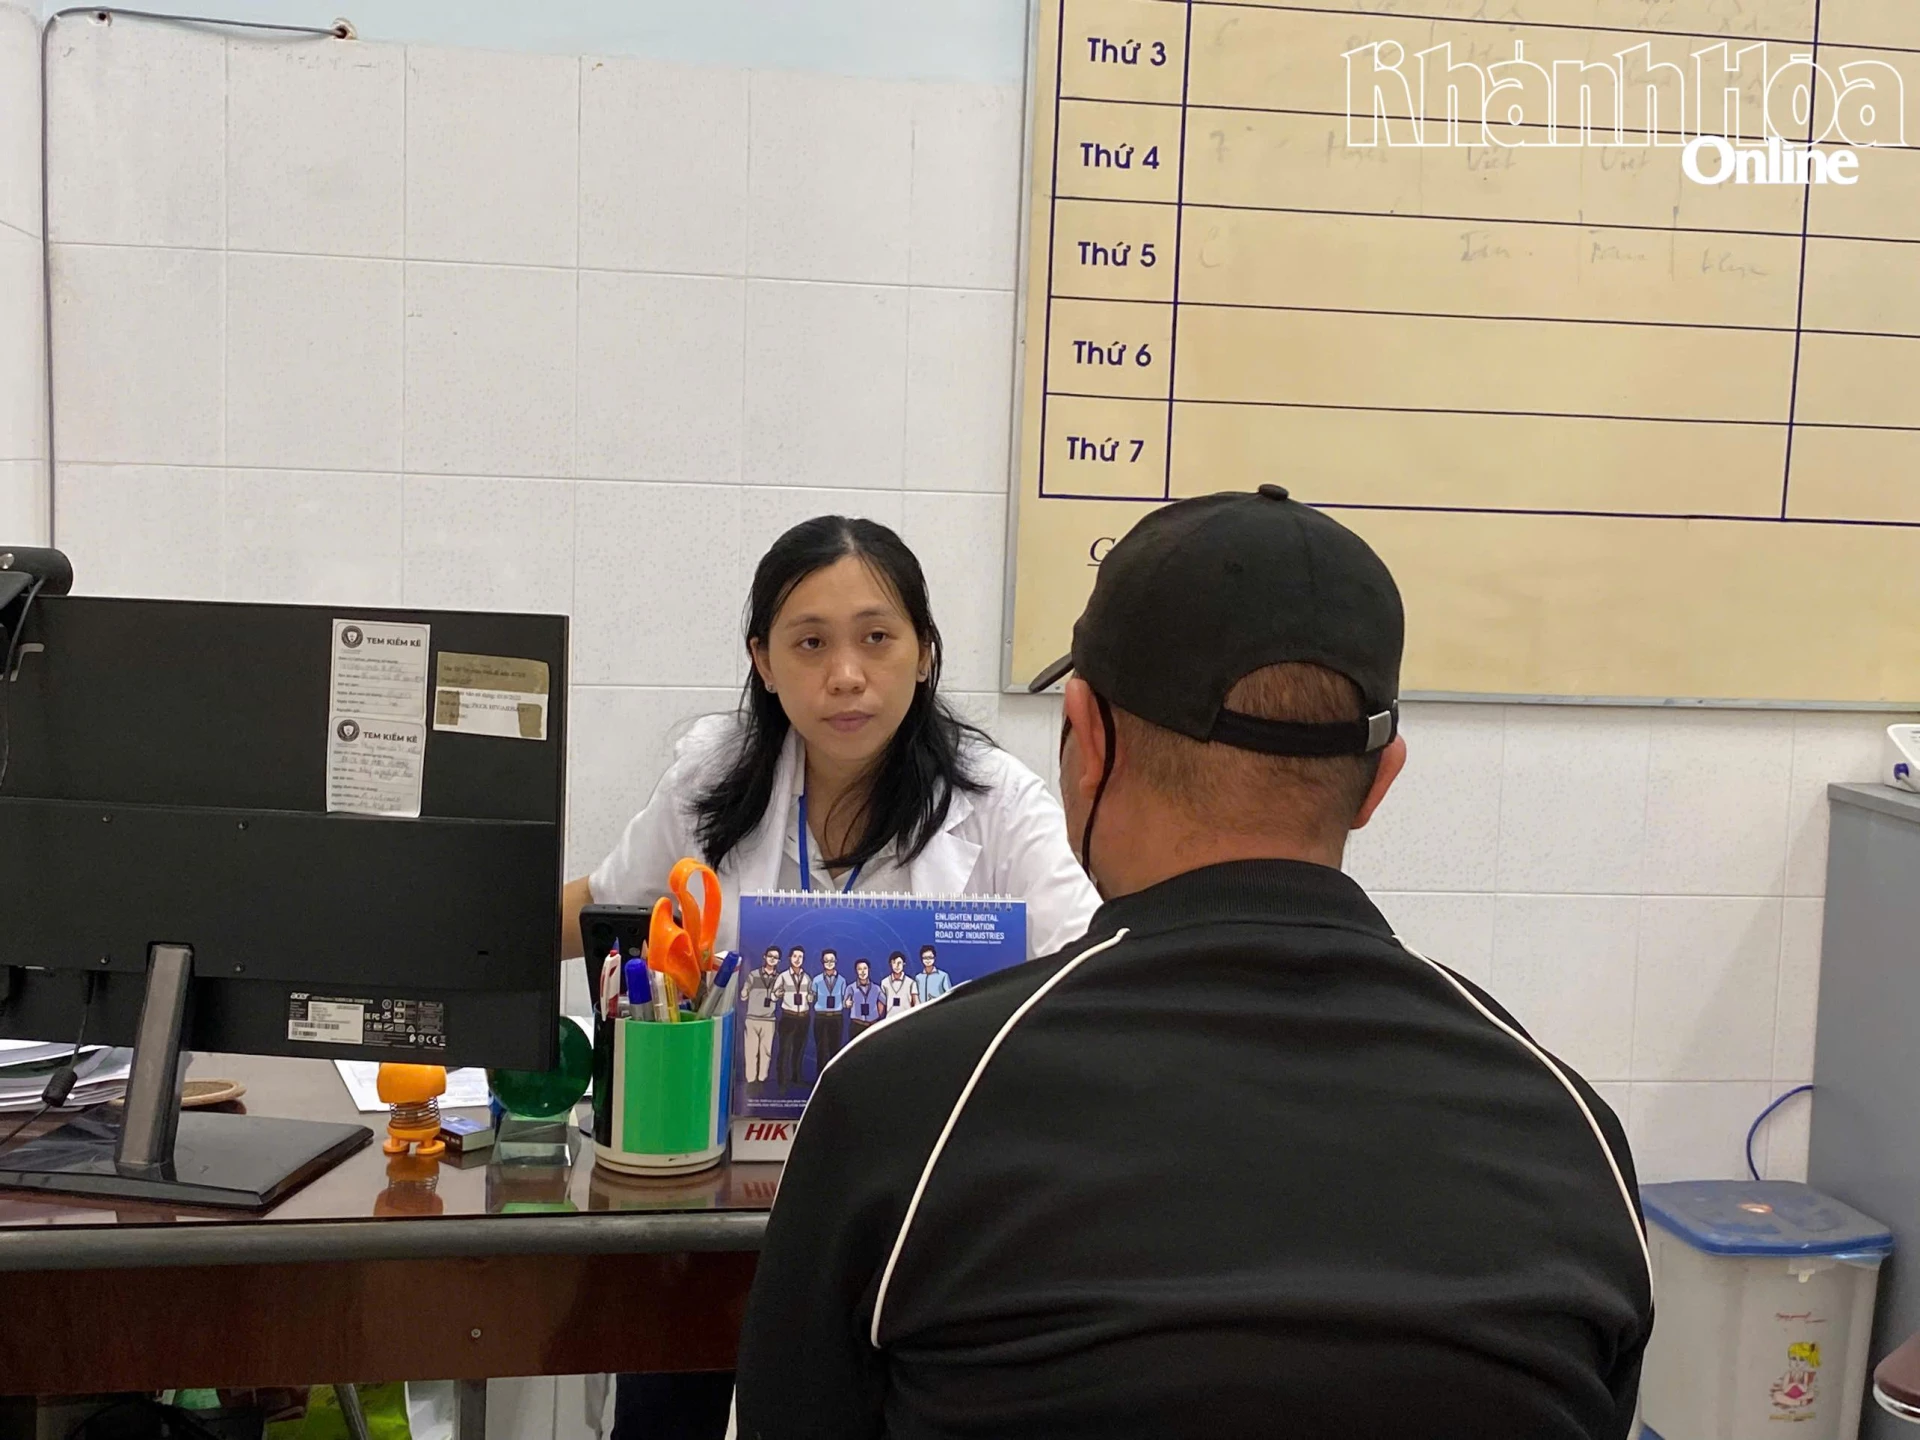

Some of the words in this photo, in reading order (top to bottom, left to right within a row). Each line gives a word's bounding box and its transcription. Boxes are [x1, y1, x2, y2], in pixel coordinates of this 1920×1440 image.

[1087, 37, 1142, 65] Thứ
[1149, 41, 1167, 67] 3
[1079, 142, 1135, 170] Thứ
[1142, 145, 1160, 170] 4
[1077, 241, 1132, 267] Thứ
[1139, 243, 1157, 268] 5
[1072, 340, 1127, 366] Thứ
[1135, 343, 1152, 368] 6
[1066, 436, 1120, 462] Thứ
[1129, 439, 1145, 463] 7
[366, 637, 385, 645] TEM
[363, 731, 381, 739] TEM
[935, 913, 972, 921] ENLIGHTEN
[973, 914, 998, 922] DIGITAL
[935, 922, 995, 931] TRANSFORMATION
[935, 931, 954, 939] ROAD
[966, 932, 1005, 940] INDUSTRIES
